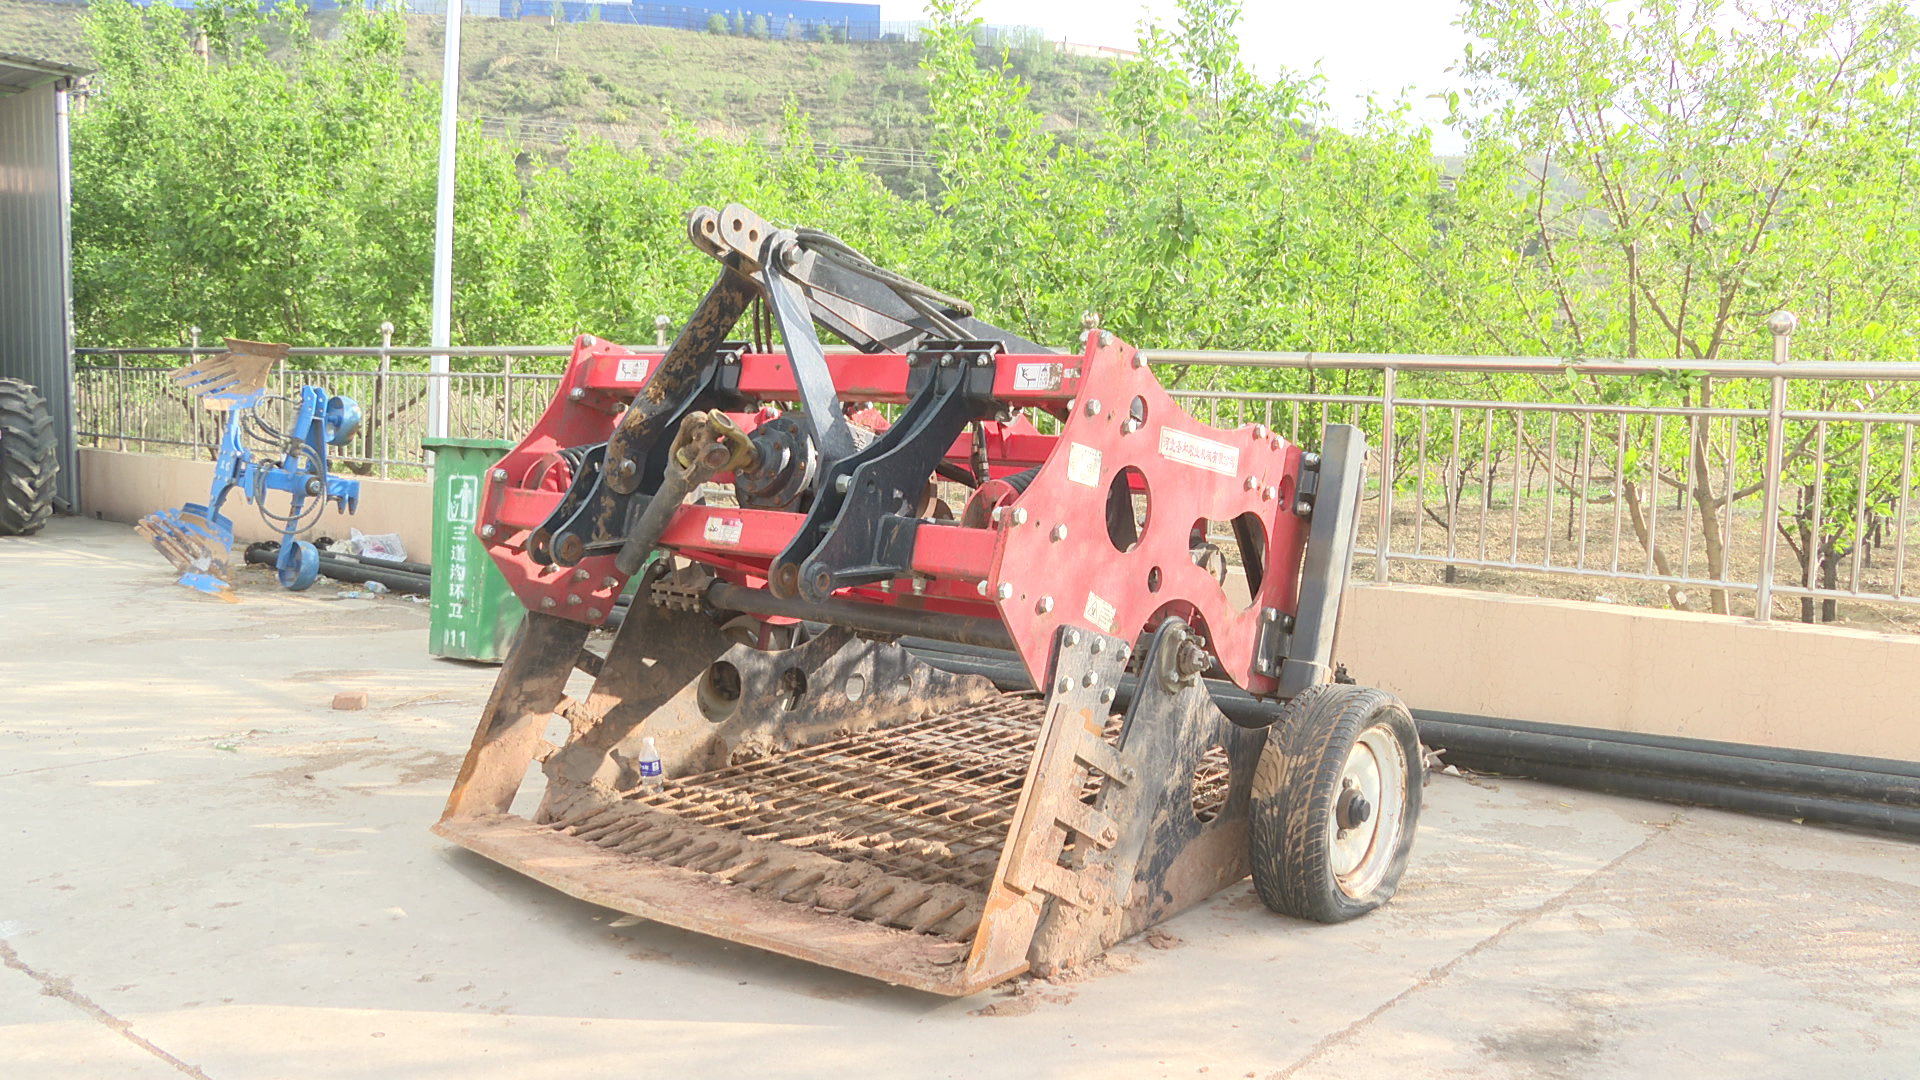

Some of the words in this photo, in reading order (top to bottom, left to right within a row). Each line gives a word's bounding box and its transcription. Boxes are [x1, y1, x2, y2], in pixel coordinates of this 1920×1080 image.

[448, 525, 467, 618] 三道沟环卫
